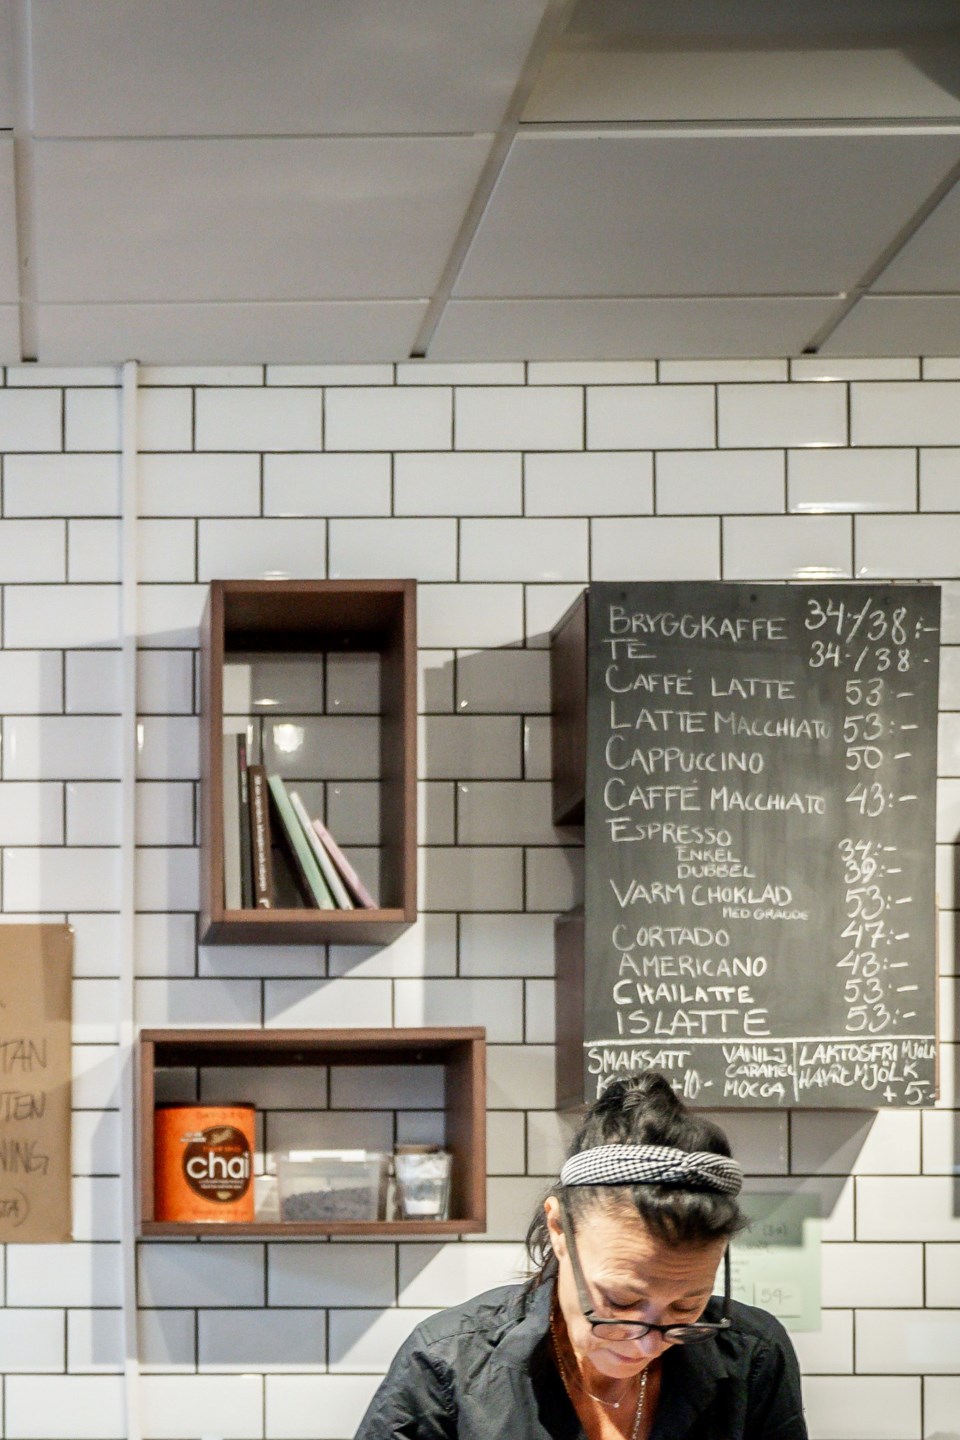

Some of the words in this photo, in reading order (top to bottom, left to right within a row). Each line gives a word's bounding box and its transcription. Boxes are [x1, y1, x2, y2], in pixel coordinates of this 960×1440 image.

[609, 604, 788, 642] BRYGGKAFFE
[603, 638, 656, 660] TE
[711, 676, 795, 699] LATTE
[610, 699, 707, 733] LATTE
[714, 710, 832, 739] MACCHIATO
[605, 734, 764, 775] CAPPUCCINO
[710, 785, 827, 814] MACCHIATO
[605, 816, 732, 847] ESPRESSO
[675, 845, 741, 863] ENKEL
[677, 864, 757, 879] DUBBEL
[609, 879, 686, 909] VARM
[691, 883, 793, 906] CHOKLAD
[722, 906, 751, 919] MED
[612, 923, 731, 951] CORTADO
[618, 952, 768, 978] AMERICANO
[612, 978, 755, 1005] CHAILATTE
[616, 1007, 771, 1036] ISLATTE
[588, 1046, 691, 1074] SMAKSATT
[722, 1045, 787, 1063] VANILJ
[799, 1042, 898, 1066] LAKTOSFRI
[724, 1080, 786, 1103] MOCCA
[186, 1150, 249, 1179] chai
